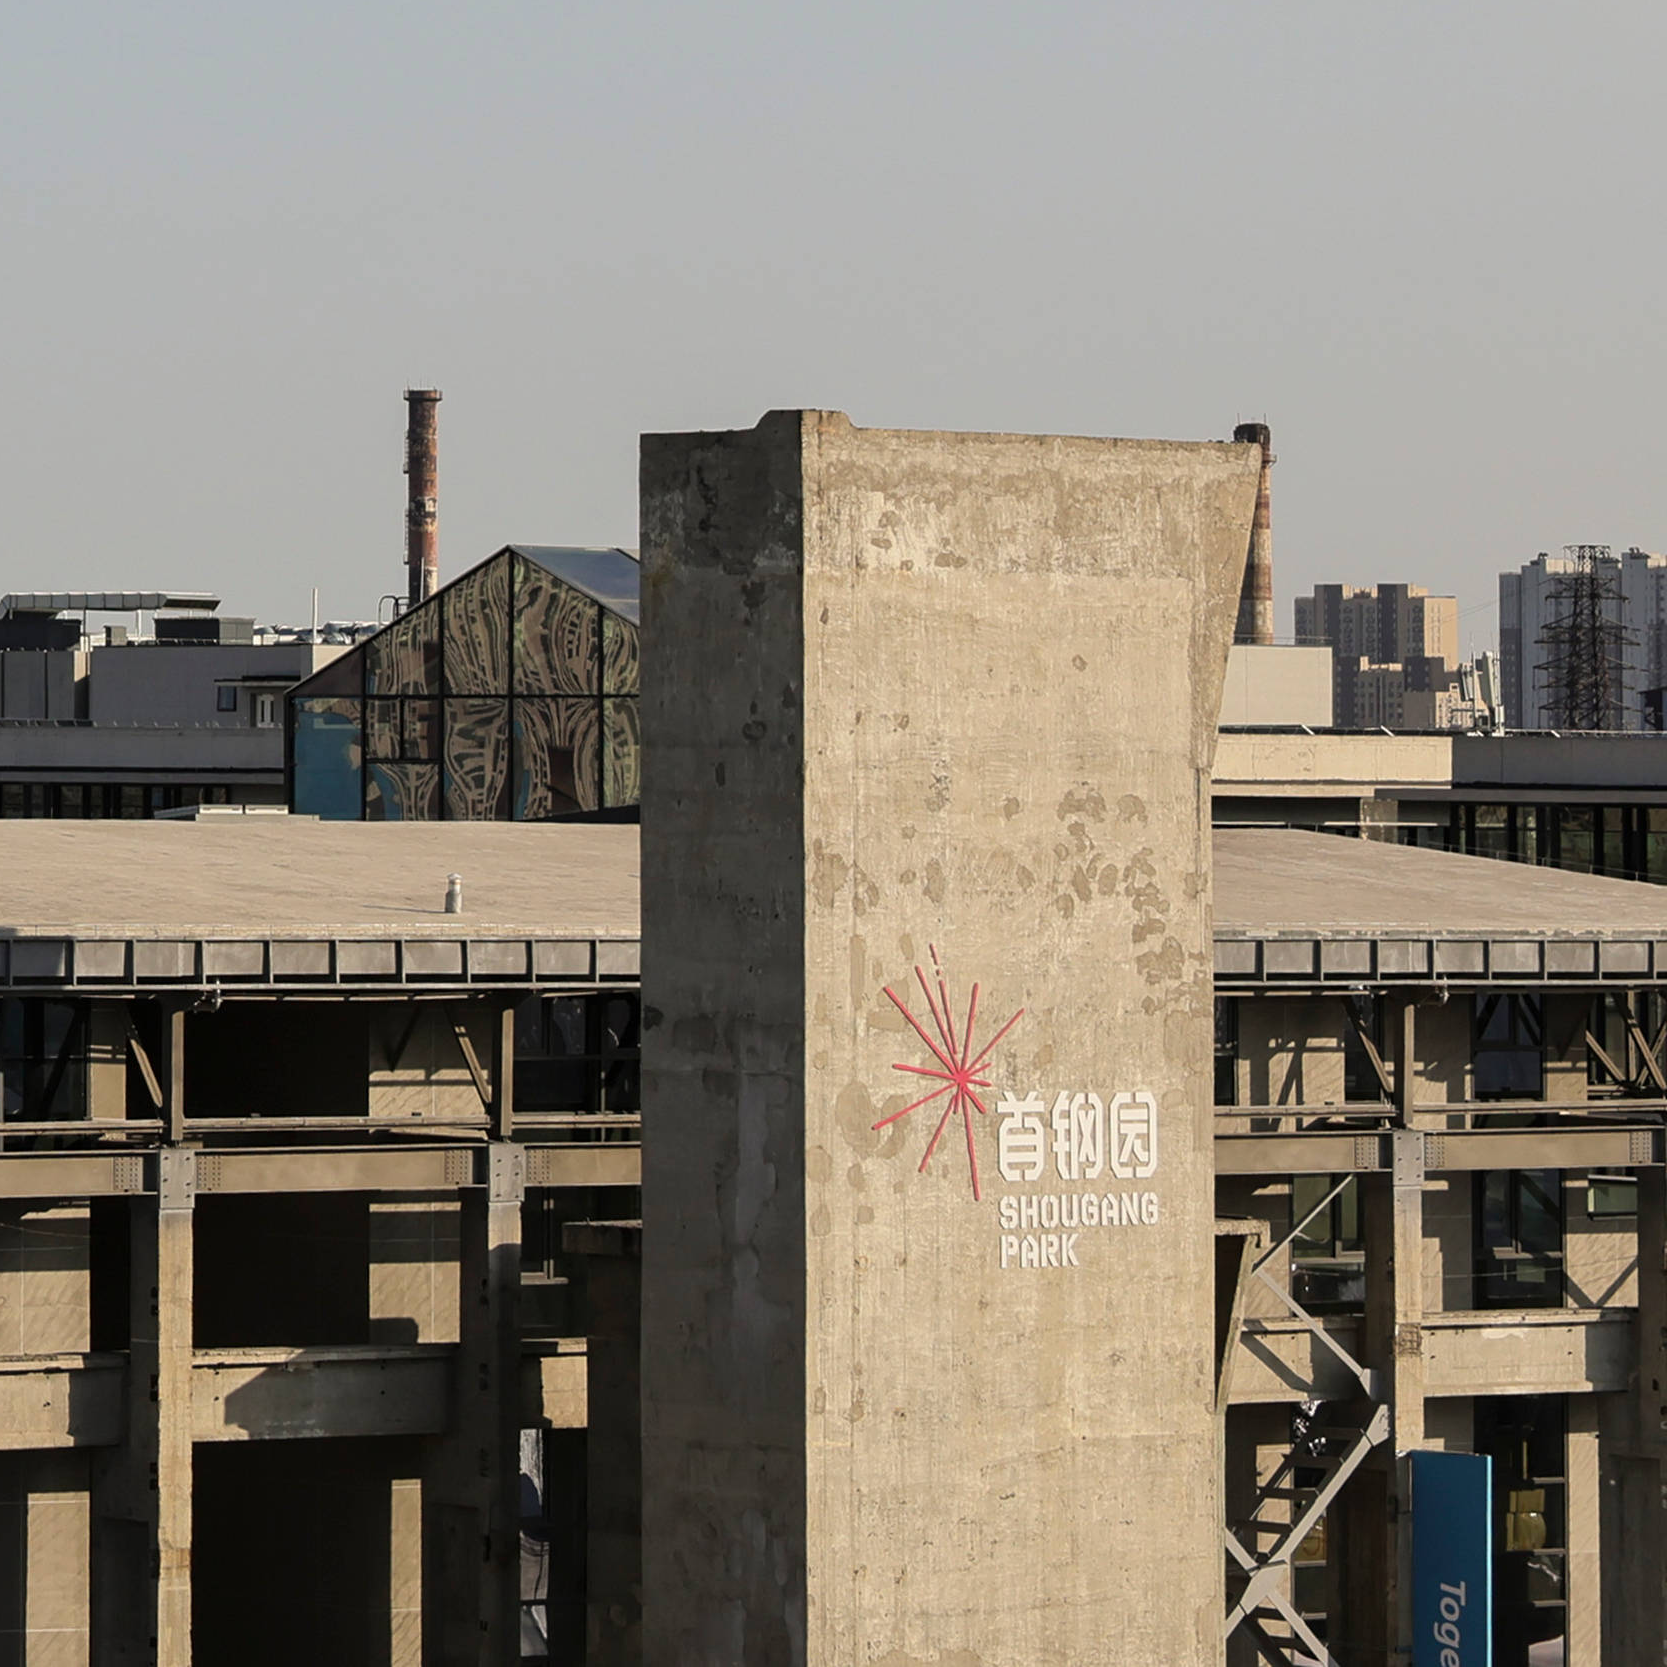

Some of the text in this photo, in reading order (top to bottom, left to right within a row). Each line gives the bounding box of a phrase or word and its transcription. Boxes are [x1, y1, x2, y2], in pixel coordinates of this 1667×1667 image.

[996, 1090, 1158, 1181] 首钢园
[998, 1192, 1159, 1228] SHOUGANG
[999, 1233, 1079, 1268] PARK
